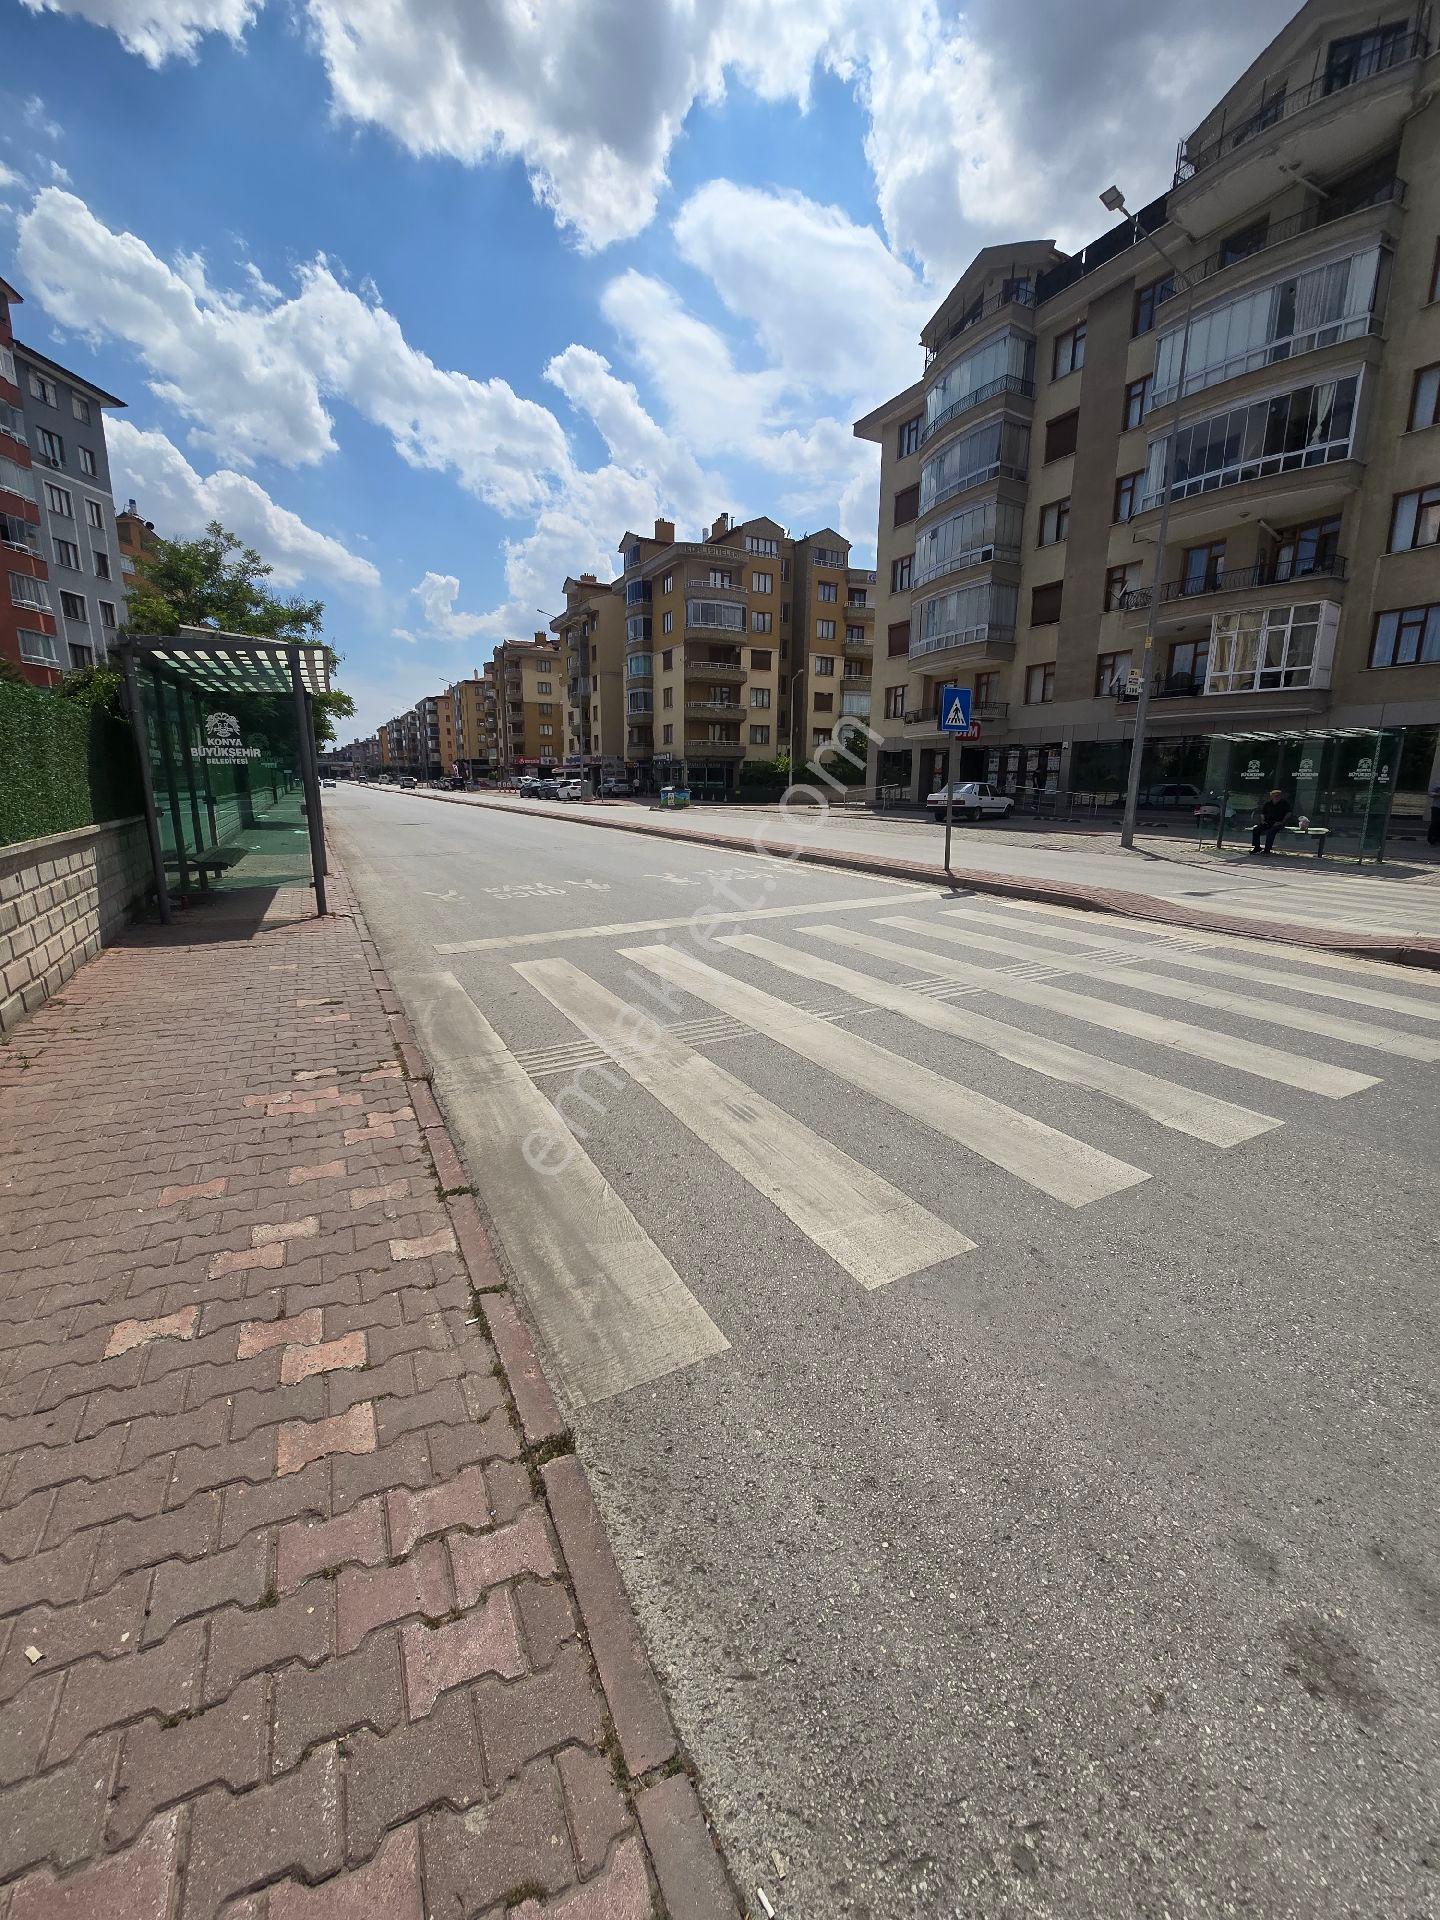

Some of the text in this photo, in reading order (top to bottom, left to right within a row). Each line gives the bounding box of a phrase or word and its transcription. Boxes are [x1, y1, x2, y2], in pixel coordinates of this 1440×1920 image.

[206, 738, 243, 746] KONYA
[190, 746, 262, 758] BÜYÜKŞEHİR
[206, 757, 249, 765] BELEDİYESİ
